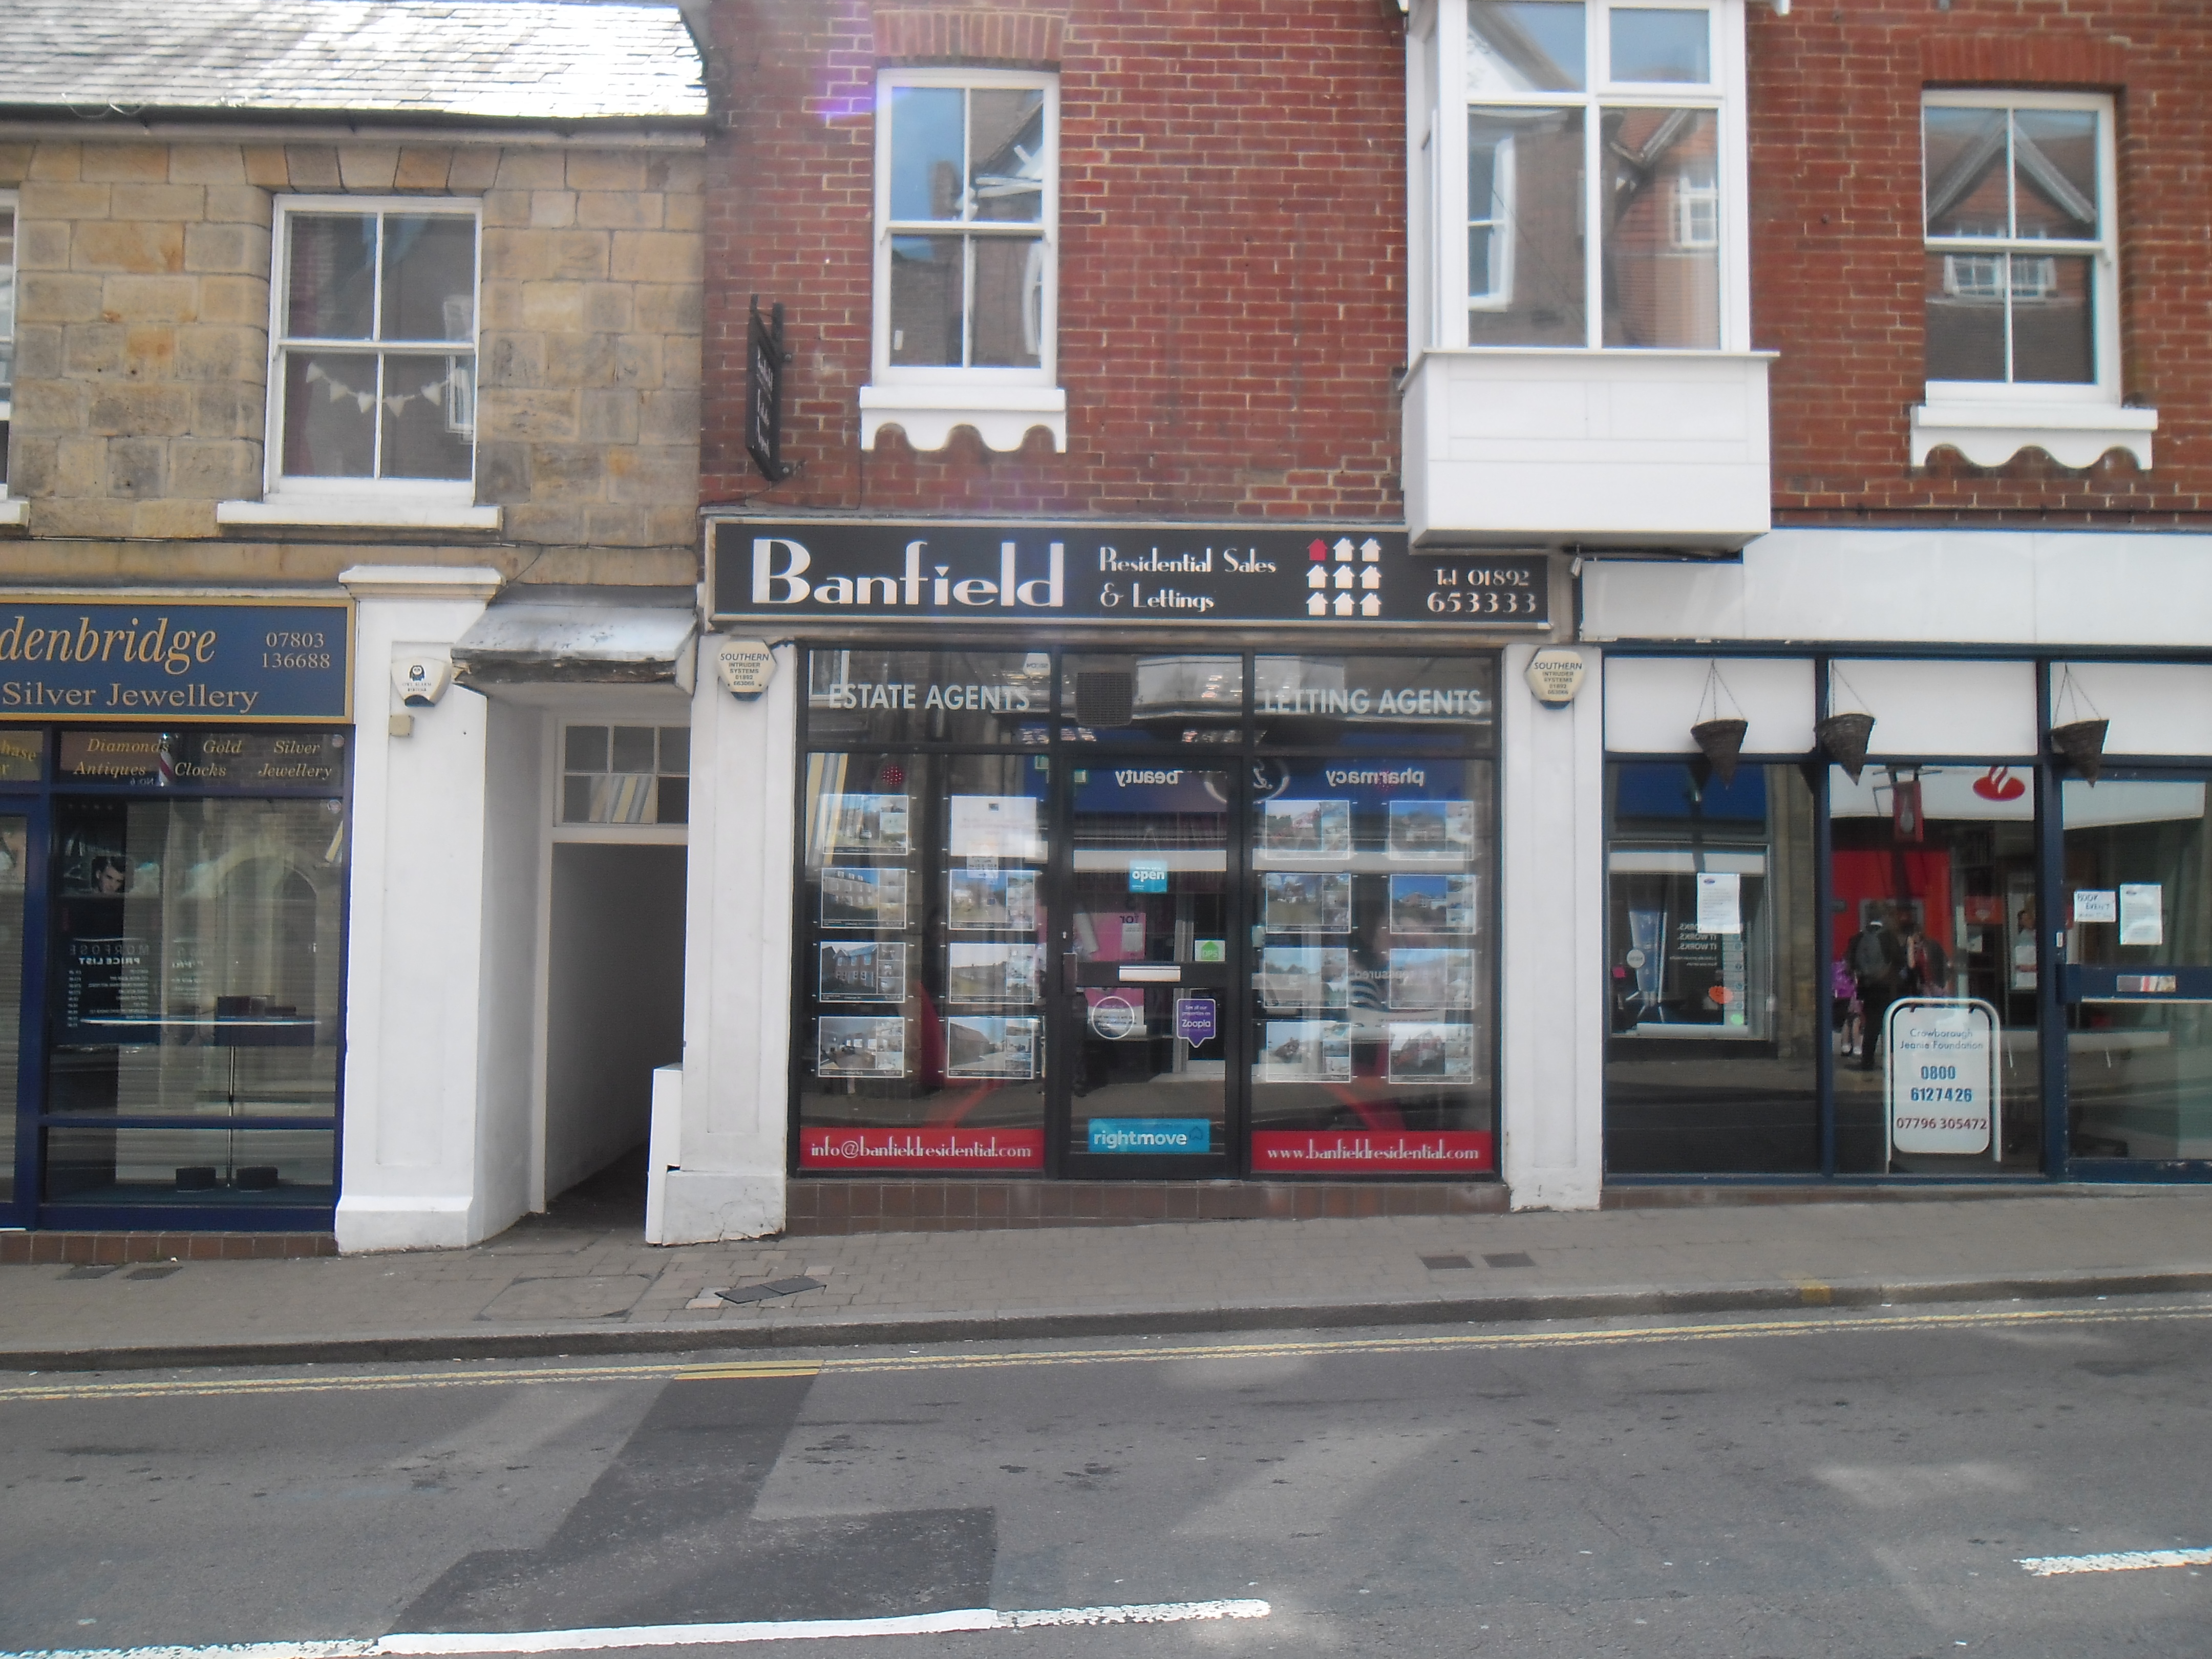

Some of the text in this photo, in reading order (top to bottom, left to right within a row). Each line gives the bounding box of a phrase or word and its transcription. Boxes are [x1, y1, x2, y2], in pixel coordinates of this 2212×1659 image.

[1099, 546, 1276, 574] Residential Sales
[752, 538, 1065, 607] Banfield
[1434, 568, 1530, 586] Tel 01892
[1100, 583, 1215, 612] & Lettings
[1427, 592, 1536, 614] 653333
[0, 616, 217, 675] denbridge
[266, 632, 325, 648] 07803
[262, 653, 330, 669] 136688
[3, 682, 259, 713] Silver Jewellery
[828, 684, 1030, 712] ESTATE AGENTS
[1263, 689, 1482, 716] LETTING AGENTS
[87, 738, 321, 755] Diamonds Gold Silver
[73, 761, 332, 778] Antiques Clocks Jewellery
[1132, 871, 1165, 882] open
[1182, 1019, 1211, 1029] Zoopla
[1910, 1029, 1973, 1039] Crowborough
[1933, 1041, 1983, 1049] Foundation
[1921, 1066, 1956, 1080] 0800
[1910, 1088, 1972, 1102] 6127426
[1897, 1117, 1987, 1130] 07796 305472
[811, 1136, 1032, 1159] info@banfieldresidential.com
[1094, 1130, 1187, 1148] rightmove
[1267, 1139, 1479, 1160] www.banfieldresidential.com
